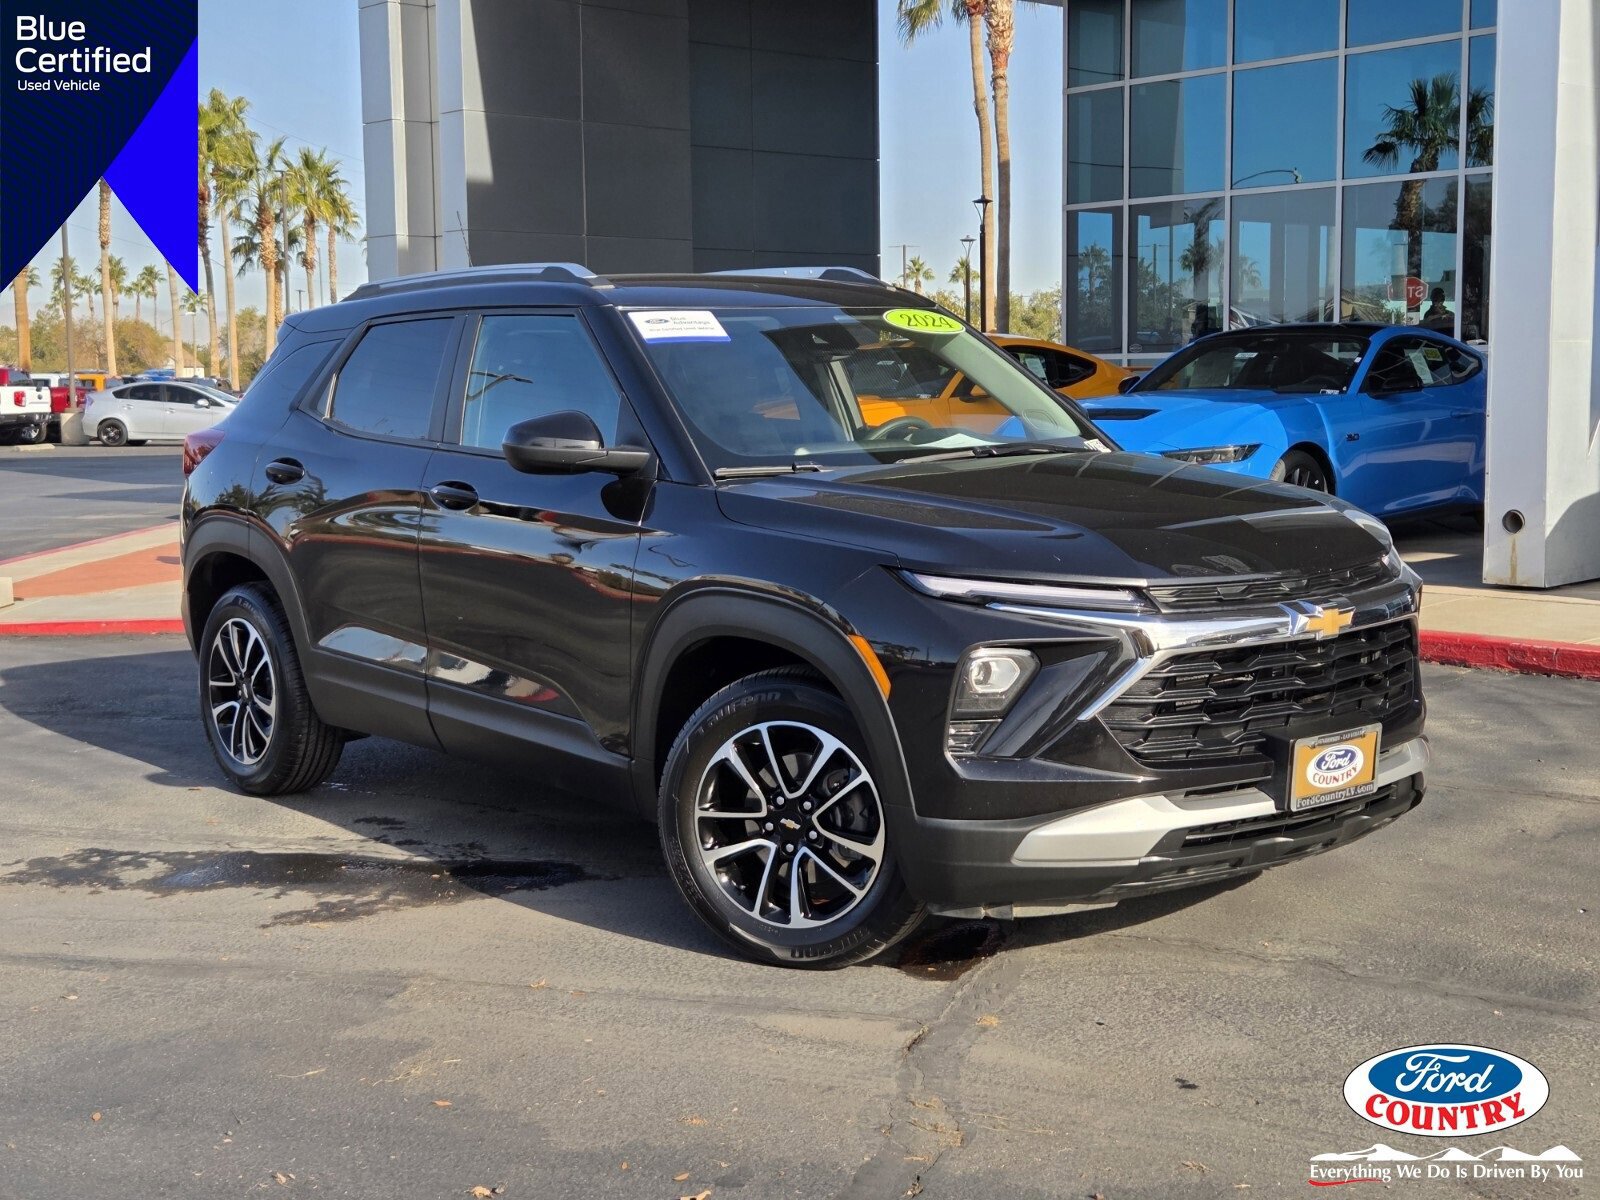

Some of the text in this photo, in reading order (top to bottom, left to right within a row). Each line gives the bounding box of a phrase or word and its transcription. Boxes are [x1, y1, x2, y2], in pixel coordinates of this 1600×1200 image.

[899, 313, 953, 329] 2024
[1321, 749, 1352, 770] Ford
[1312, 765, 1359, 785] COUNTRY
[1296, 783, 1374, 808] FordCountryLV.Com
